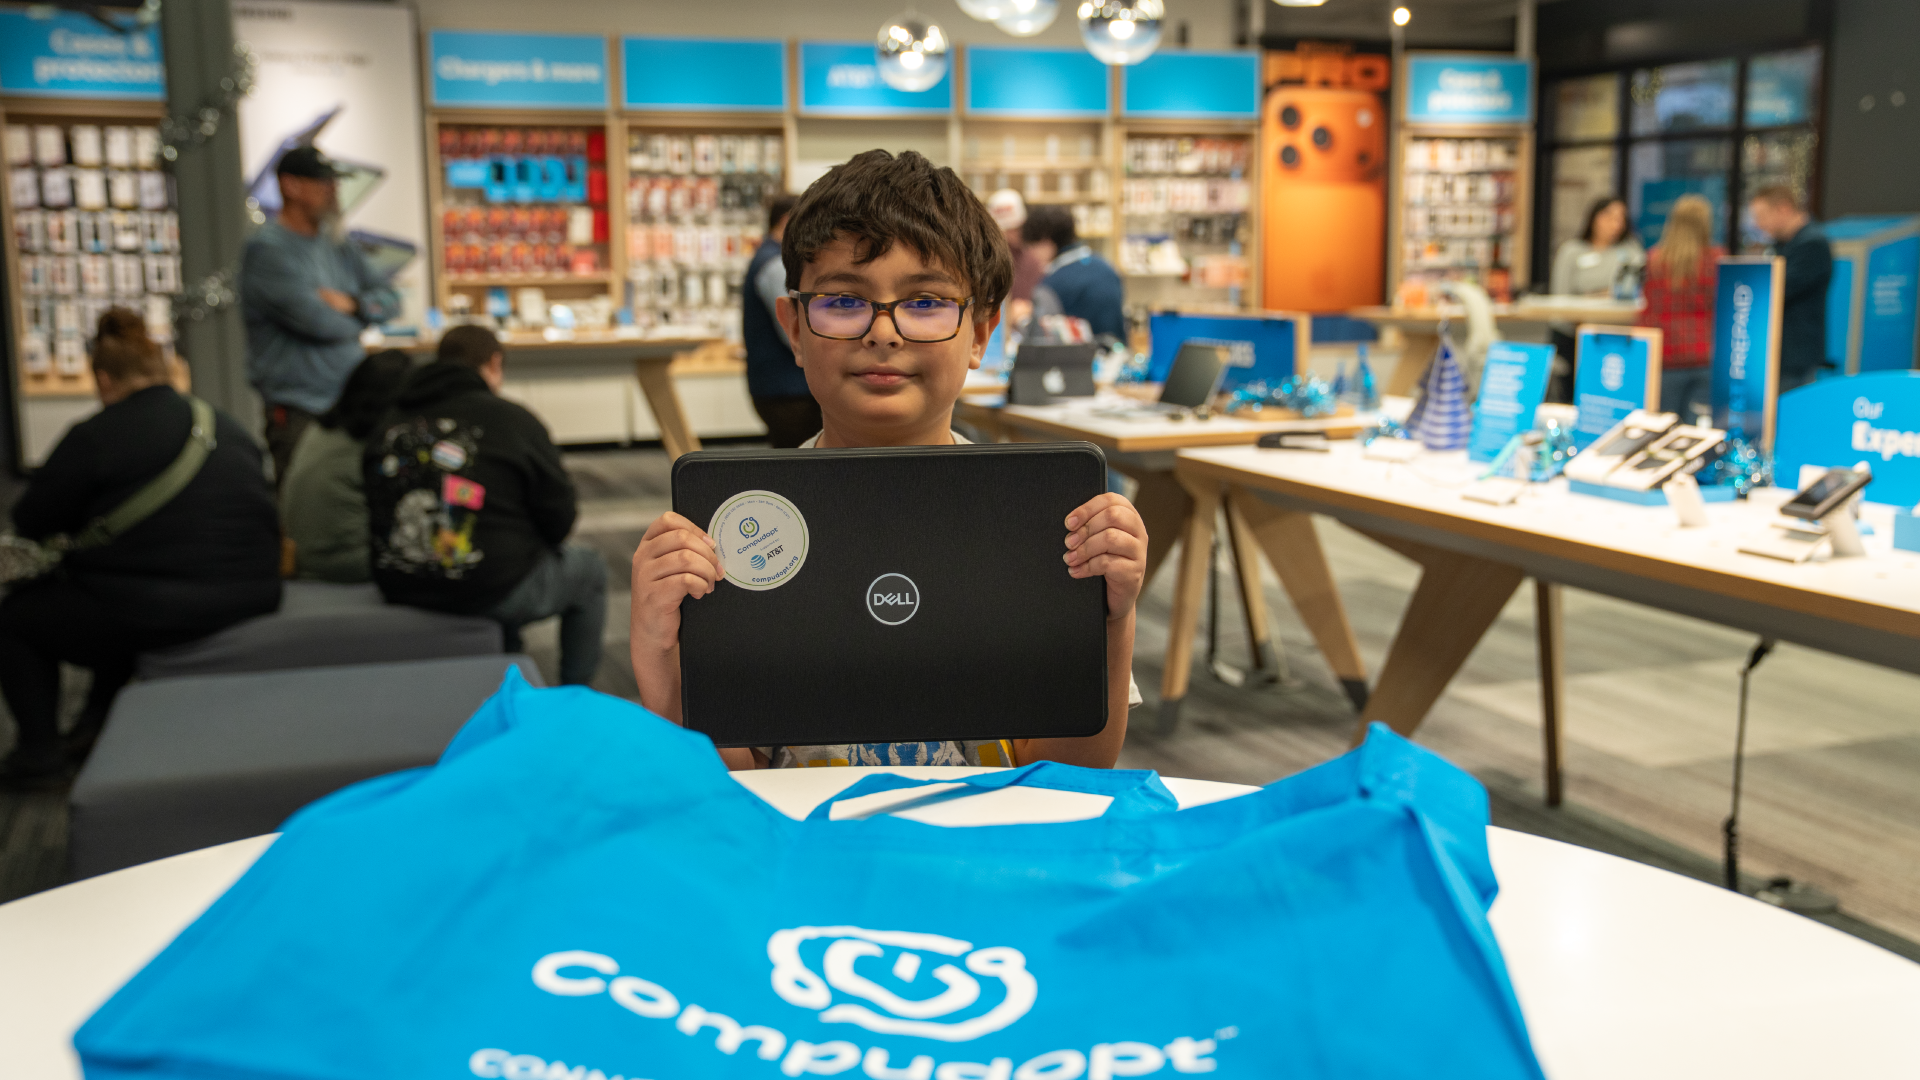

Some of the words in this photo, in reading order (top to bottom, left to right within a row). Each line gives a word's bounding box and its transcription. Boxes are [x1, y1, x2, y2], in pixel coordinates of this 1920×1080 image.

[1729, 285, 1754, 380] PREPAID
[1853, 397, 1884, 419] Our
[737, 527, 778, 555] Compudopt
[766, 545, 784, 560] AT&T
[752, 556, 799, 583] compudopt.org
[873, 592, 915, 606] DELL
[532, 950, 1217, 1080] Compudopt
